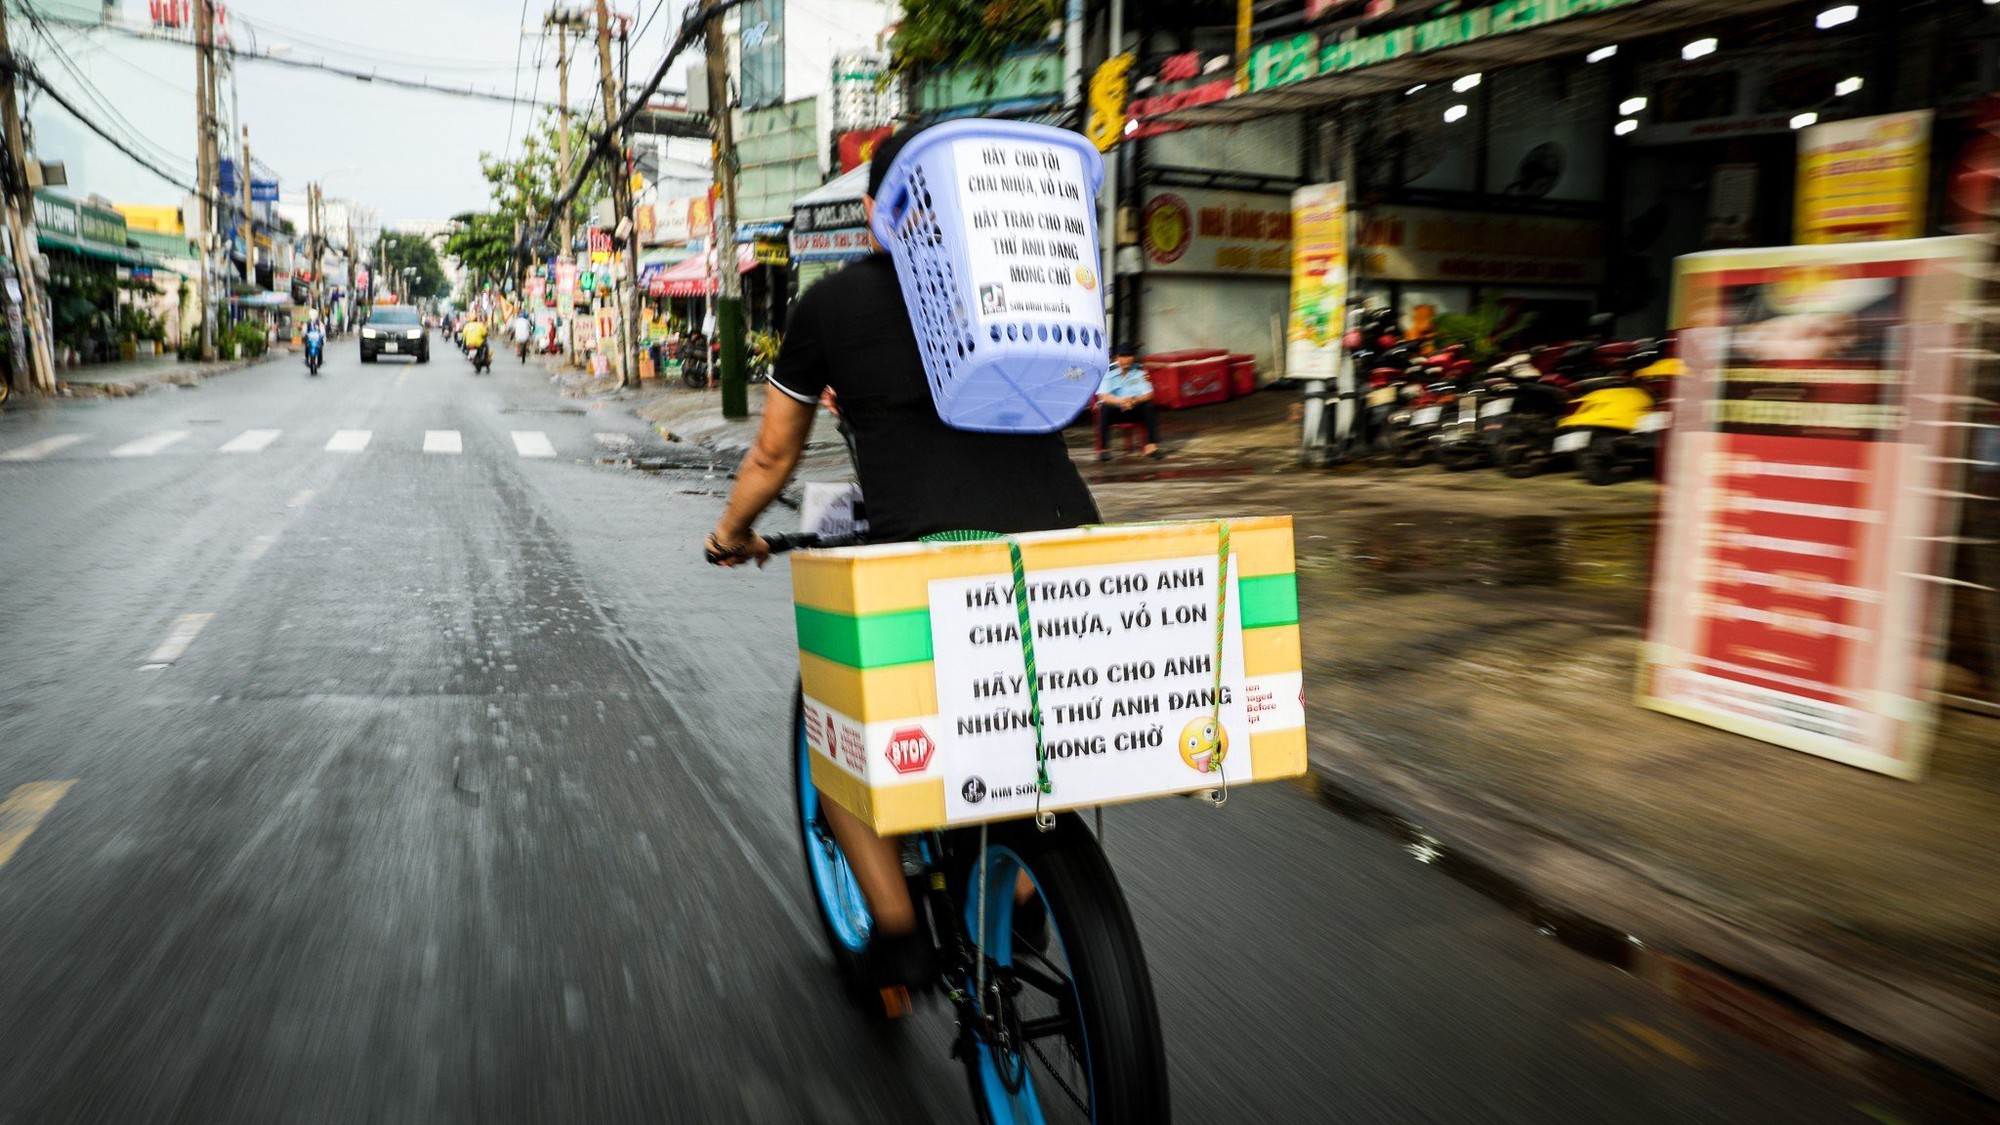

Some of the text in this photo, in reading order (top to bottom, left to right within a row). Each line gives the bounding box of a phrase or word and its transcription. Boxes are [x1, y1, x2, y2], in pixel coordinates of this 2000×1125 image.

[982, 143, 1060, 171] HÃY CHO TÔI
[968, 175, 998, 193] CHAI
[1058, 179, 1079, 201] LON
[973, 205, 1085, 236] HÃY TRAO CHO ANH
[1021, 237, 1046, 256] ANH
[1009, 264, 1046, 284] MONG
[966, 567, 1204, 608] HÃY TRAO CHO ANH
[969, 601, 1208, 645] CHA NHỰA, VỎ LON
[973, 653, 1212, 698] HÃY TRAO CHO ANH
[1051, 695, 1104, 724] THỨ
[1111, 693, 1160, 718] ANH
[1168, 685, 1232, 711] ĐANG
[890, 737, 929, 766] STOP
[1036, 723, 1164, 762] MONG CHỜ
[990, 785, 1012, 799] KIM
